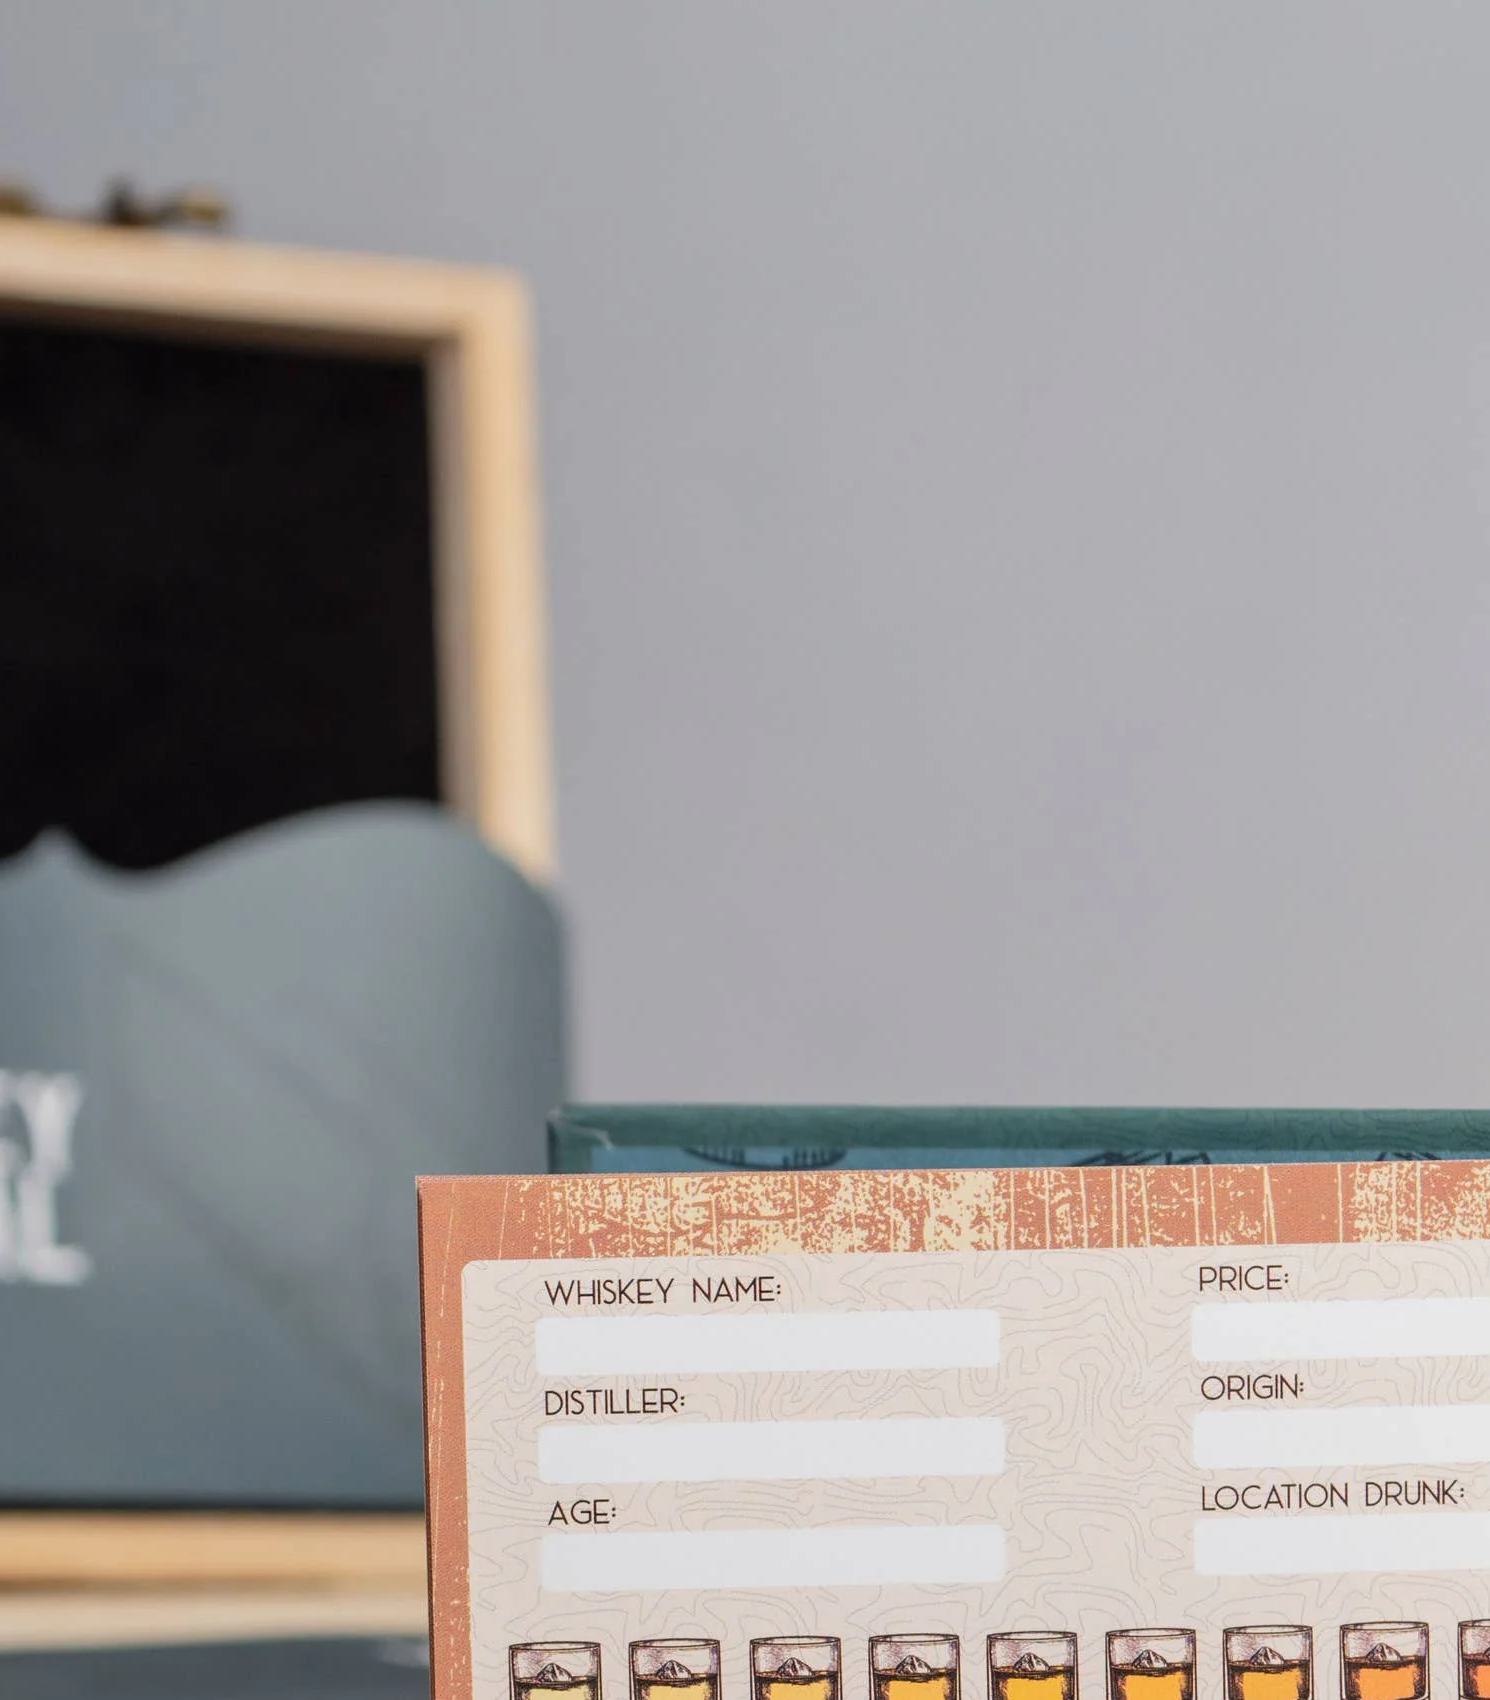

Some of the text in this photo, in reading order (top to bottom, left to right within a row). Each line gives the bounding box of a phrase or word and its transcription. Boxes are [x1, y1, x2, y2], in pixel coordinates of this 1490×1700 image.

[544, 1275, 783, 1306] WHISKEY NAME:
[1198, 1264, 1290, 1292] PRICE:
[1200, 1374, 1305, 1401] ORIGIN:
[544, 1388, 687, 1416] DISTILLER:
[1200, 1480, 1465, 1512] LOCATION DRUNK:
[548, 1499, 618, 1527] AGE:
